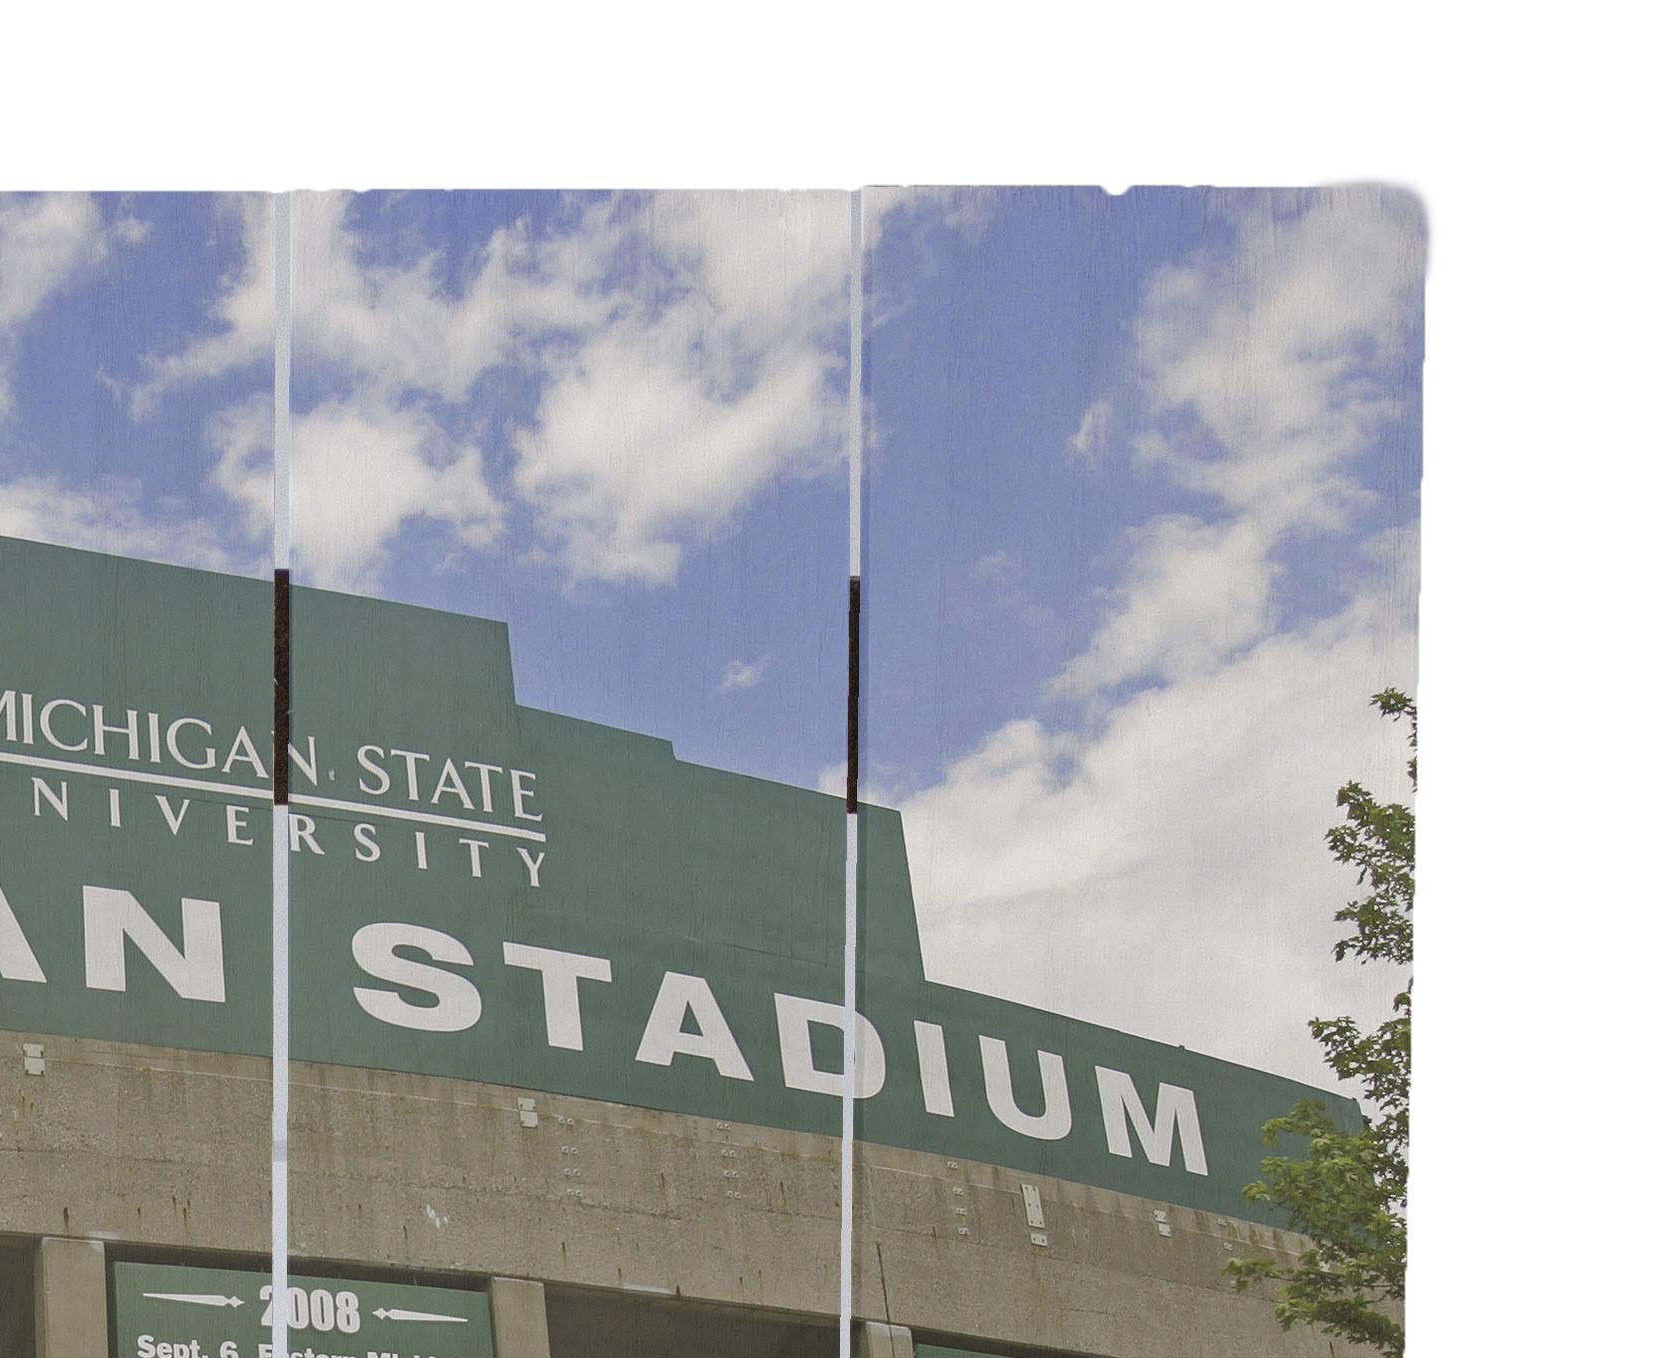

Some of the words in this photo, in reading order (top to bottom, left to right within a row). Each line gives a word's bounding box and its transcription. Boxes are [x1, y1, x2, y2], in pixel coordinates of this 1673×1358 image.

[357, 745, 544, 822] STATE
[351, 921, 1209, 1176] STADIUM
[259, 1284, 361, 1333] 2008
